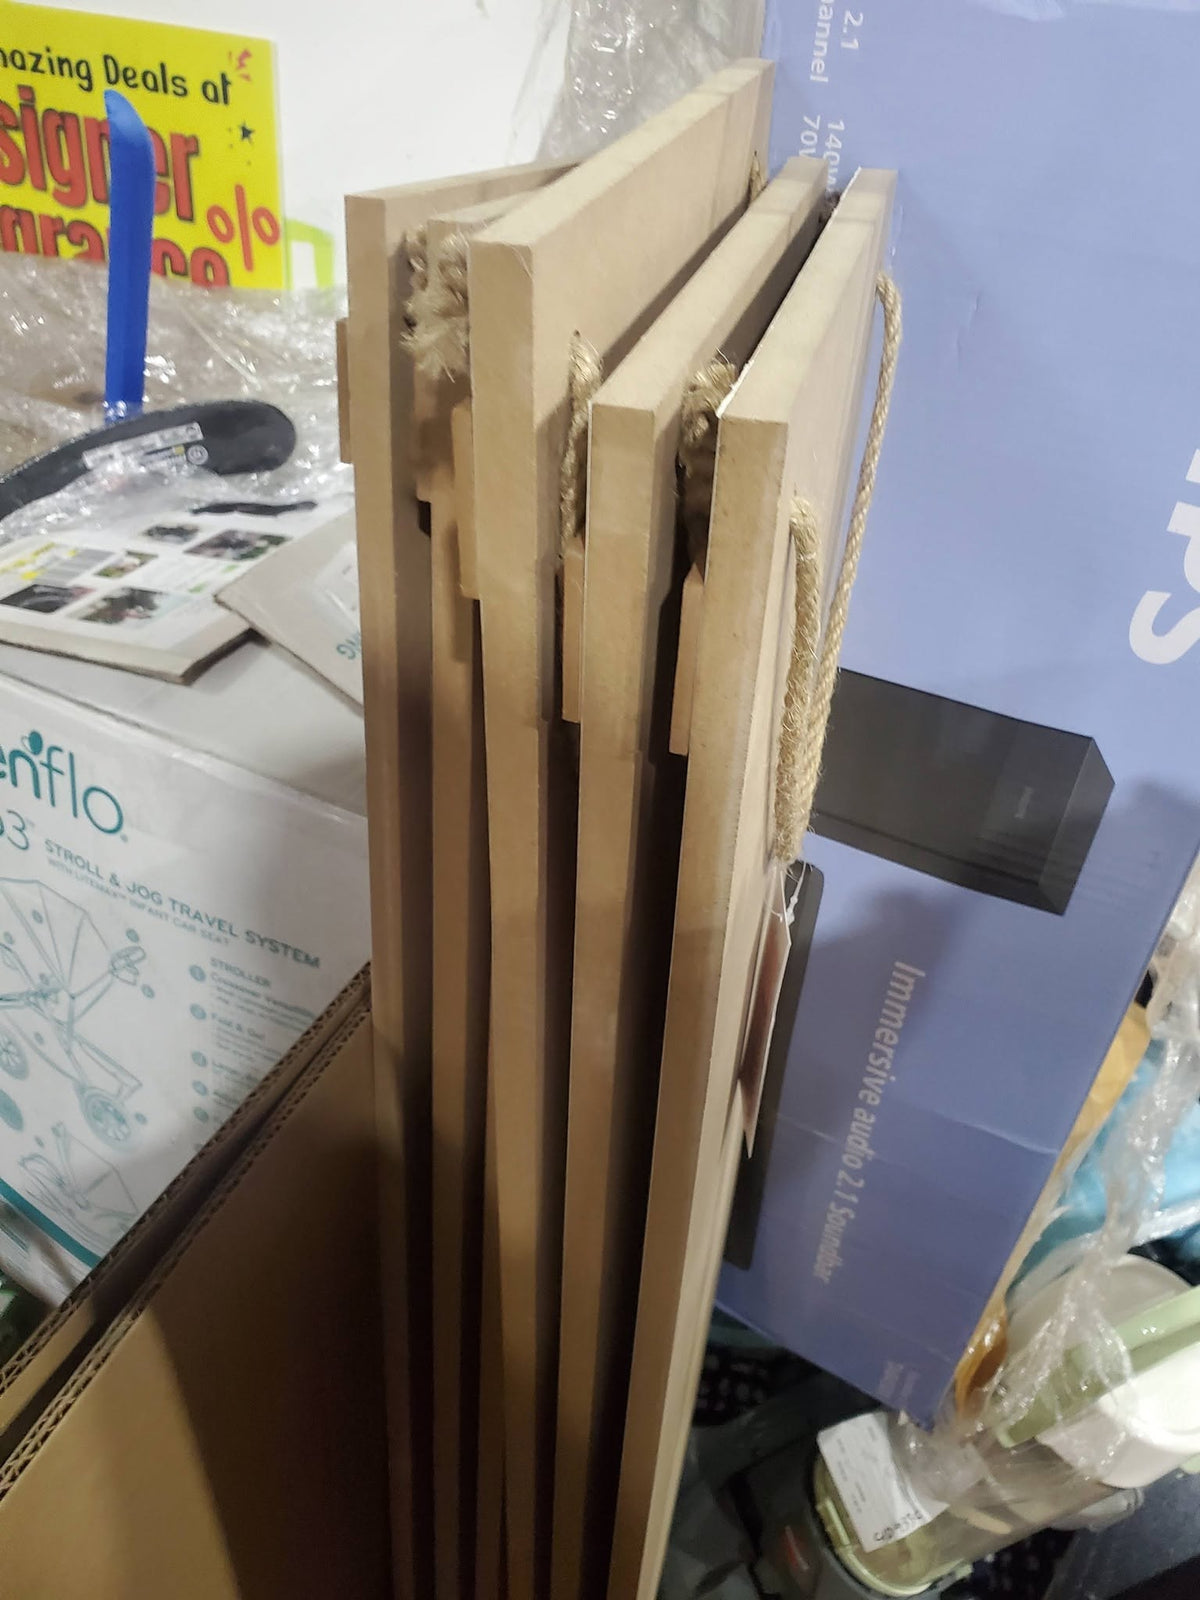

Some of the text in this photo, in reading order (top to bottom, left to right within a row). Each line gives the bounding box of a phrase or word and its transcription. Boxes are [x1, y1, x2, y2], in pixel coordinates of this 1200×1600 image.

[810, 0, 834, 82] annel
[841, 10, 863, 49] 2.1
[103, 54, 188, 97] Deals
[202, 73, 232, 105] at
[44, 838, 320, 969] STROLL & JOG TRAVEL SYSTEM
[859, 961, 926, 1105] Immersive
[842, 1106, 876, 1169] audio
[834, 1169, 865, 1203] 2.1
